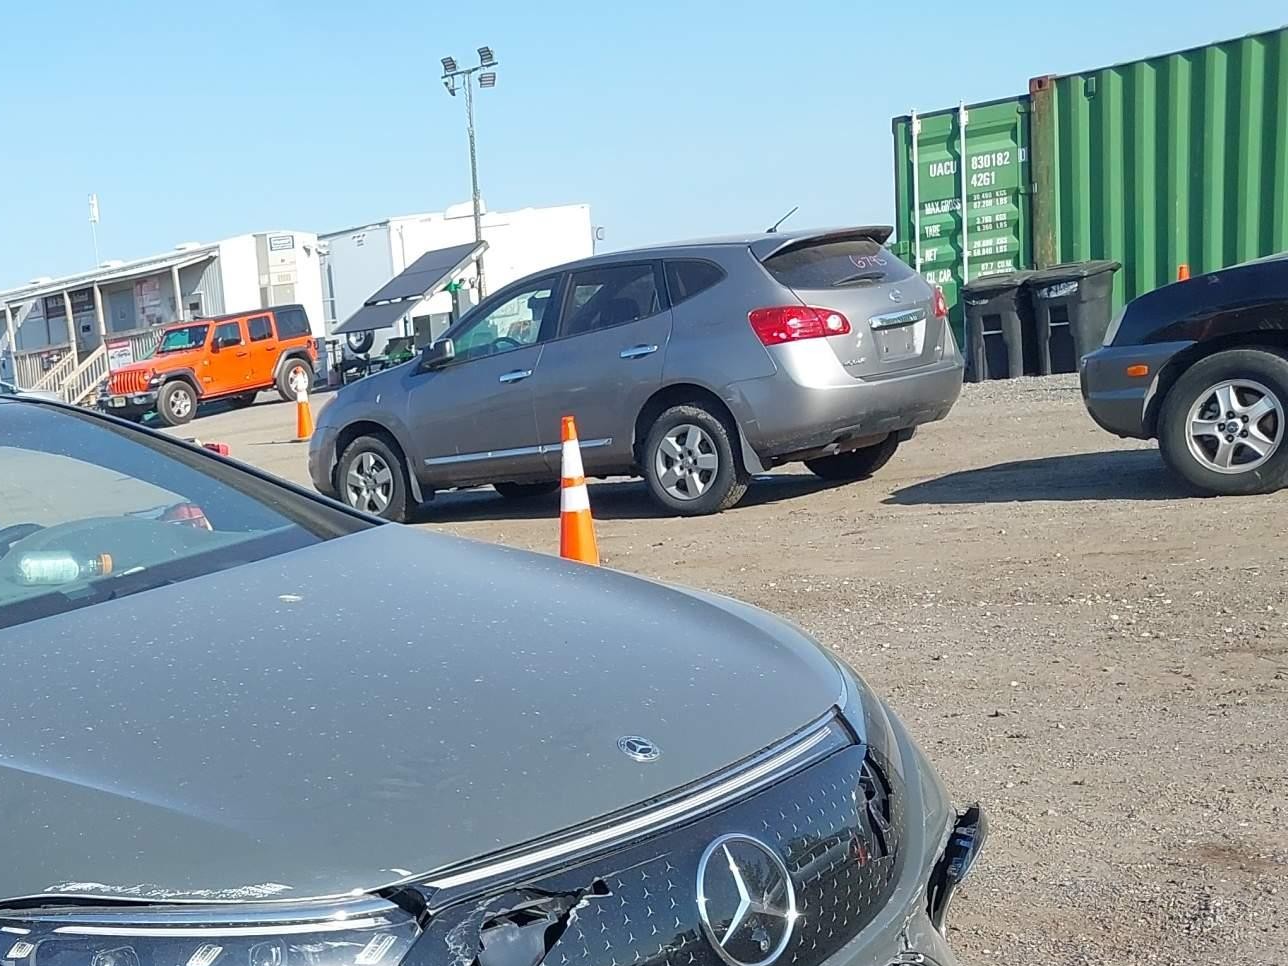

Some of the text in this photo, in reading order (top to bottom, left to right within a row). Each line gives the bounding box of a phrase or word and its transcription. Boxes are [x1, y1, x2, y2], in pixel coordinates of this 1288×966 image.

[929, 161, 957, 177] UACU
[971, 151, 1011, 170] 830182
[971, 171, 996, 188] 4261
[924, 224, 941, 238] TARE
[925, 248, 938, 262] NET
